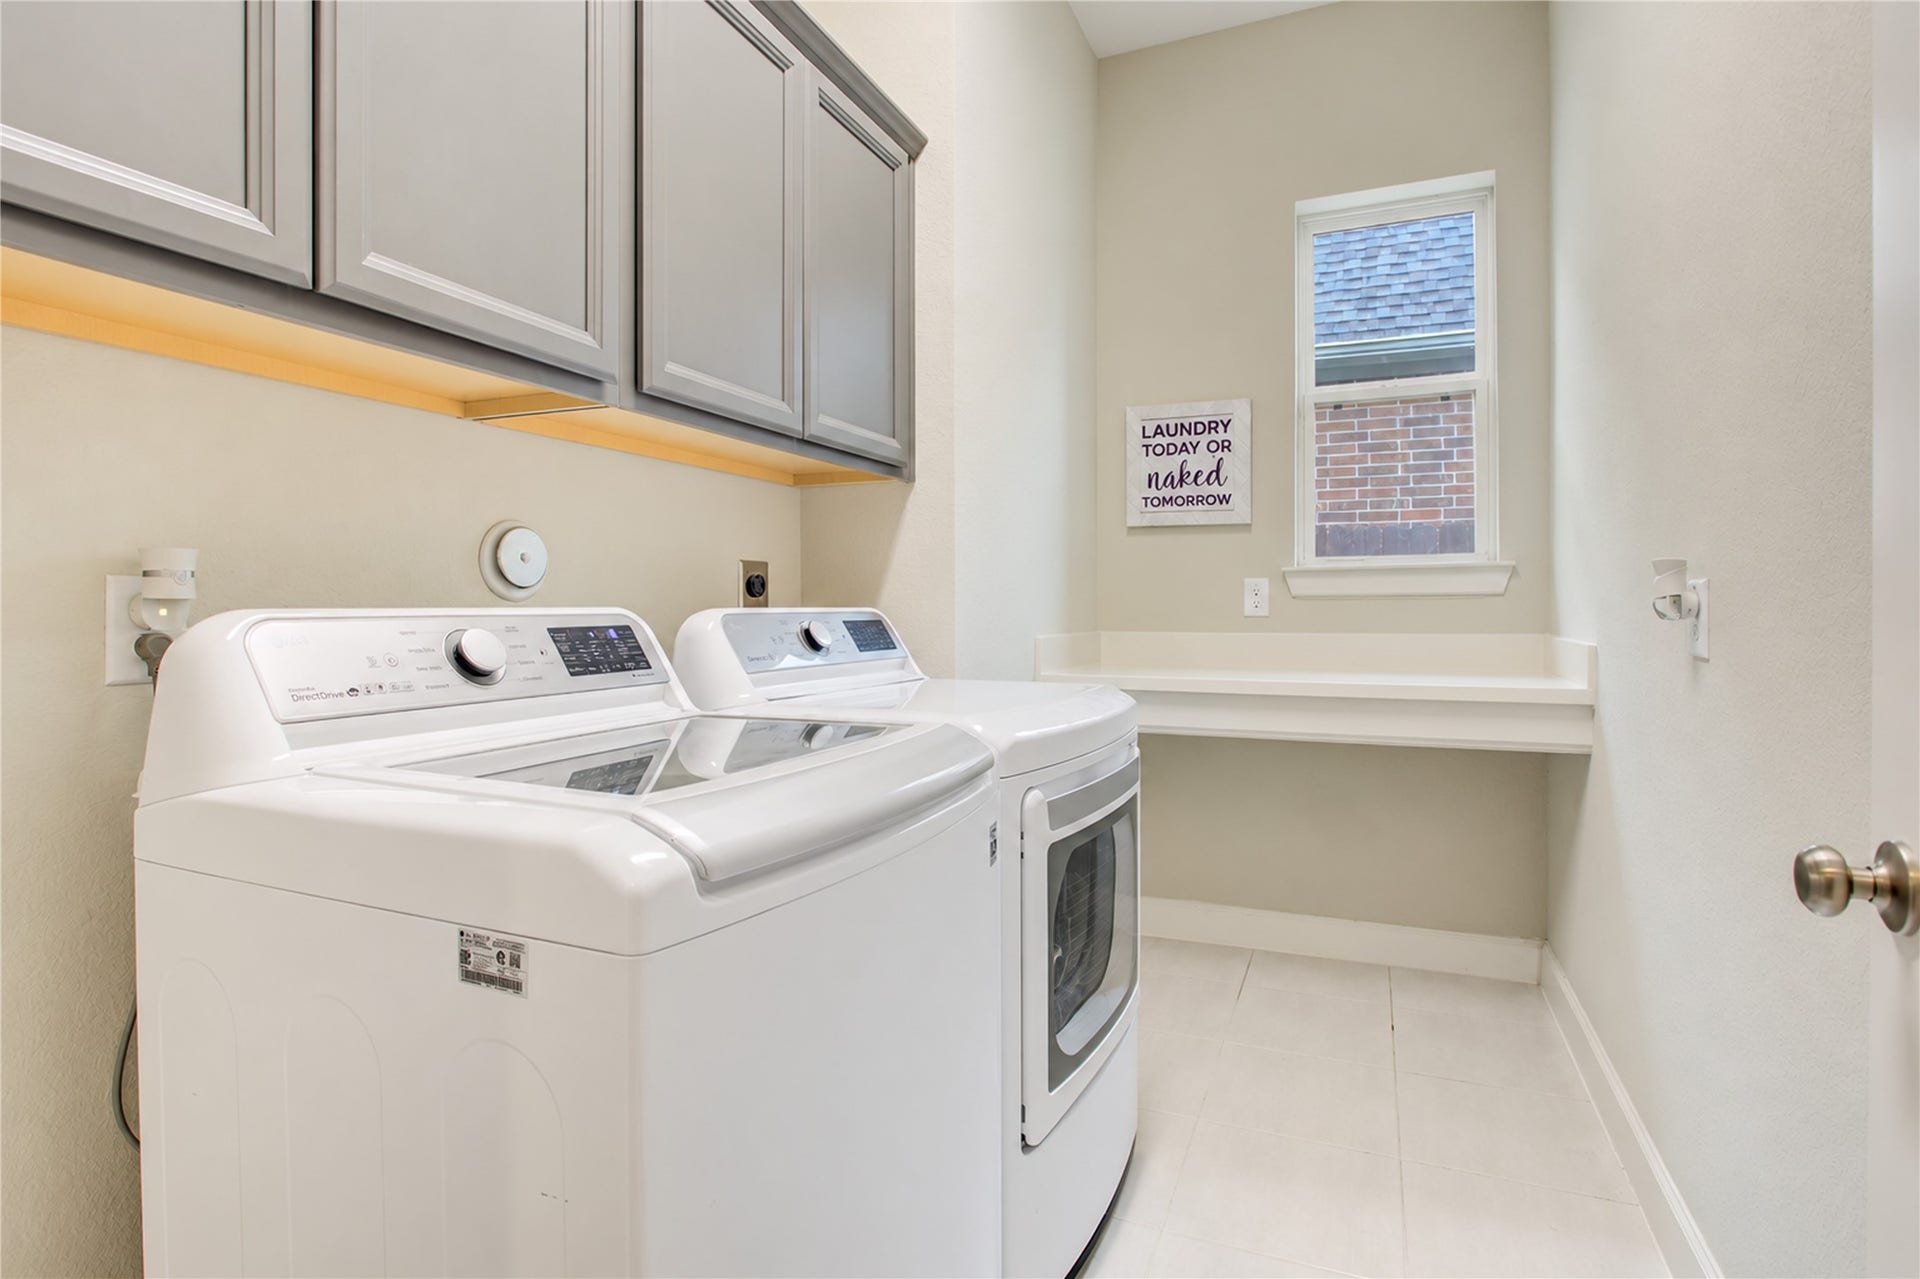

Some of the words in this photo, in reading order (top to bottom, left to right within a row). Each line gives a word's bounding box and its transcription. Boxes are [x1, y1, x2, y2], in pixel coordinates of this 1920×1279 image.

[1141, 418, 1232, 439] LAUNDRY
[1141, 440, 1201, 457] TODAY
[1206, 439, 1232, 454] OR
[1147, 457, 1228, 491] naked
[1141, 493, 1232, 508] TOMORROW
